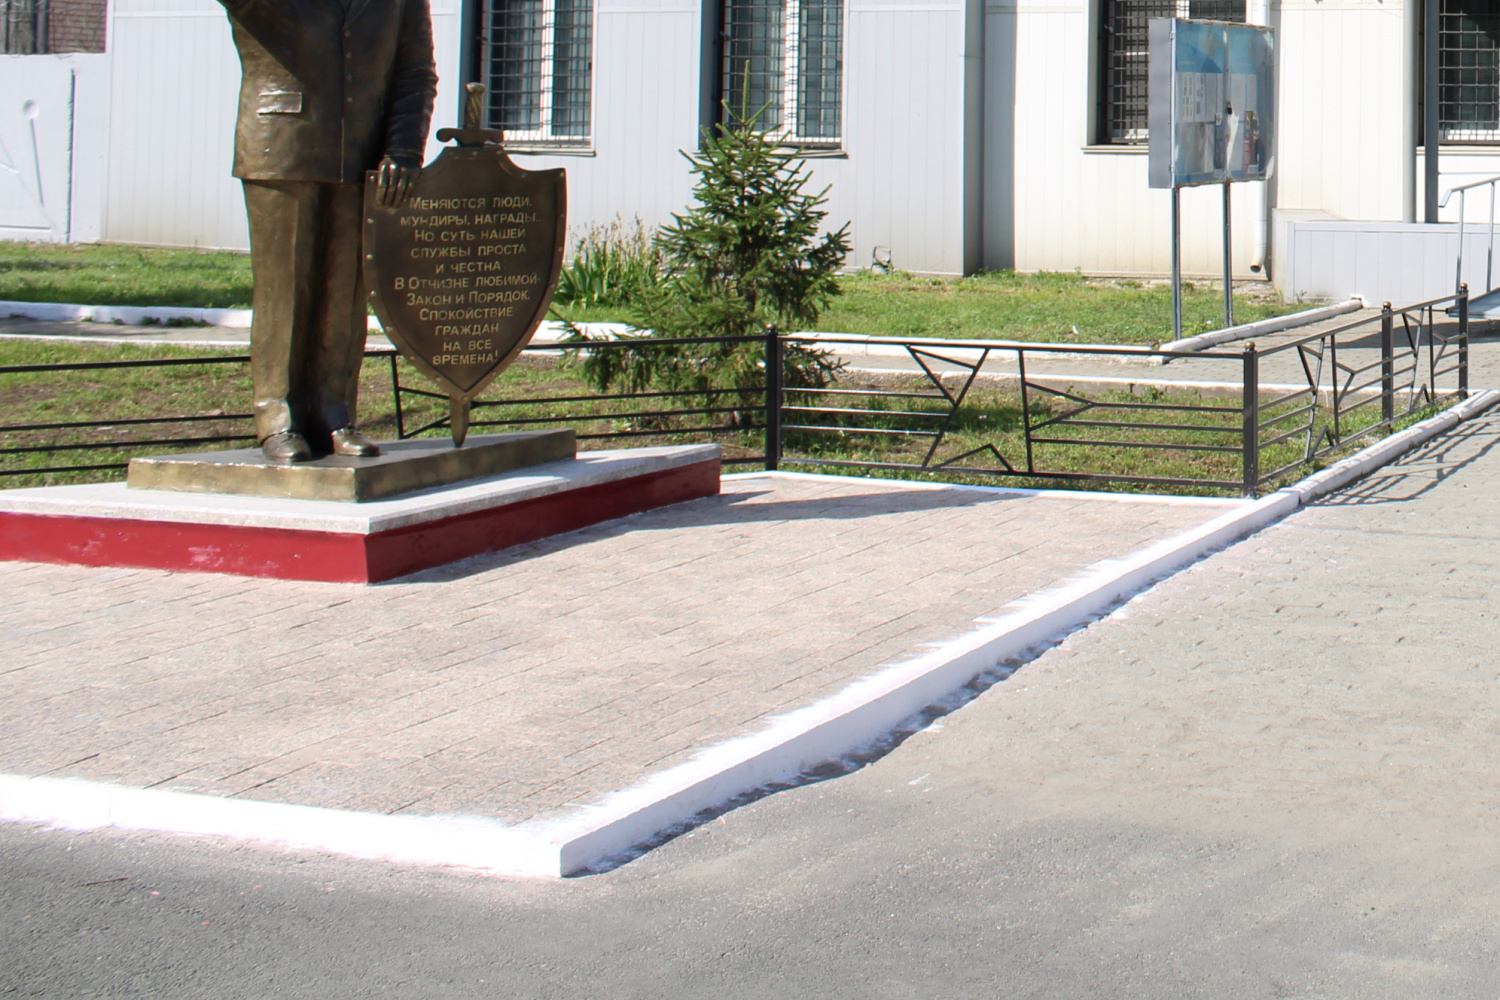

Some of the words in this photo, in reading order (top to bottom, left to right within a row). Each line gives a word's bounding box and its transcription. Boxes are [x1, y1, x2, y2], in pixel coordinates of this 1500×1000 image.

[440, 229, 476, 241] СУТЬ
[480, 225, 527, 240] НАШЕЙ
[410, 245, 471, 259] СЛУЖБЫ
[477, 243, 527, 257] ПРОСТА
[435, 263, 445, 274] И
[394, 277, 404, 290] В
[408, 276, 470, 290] ОТЧИЗНЕ
[406, 293, 452, 306] ЗАКОН
[455, 294, 465, 304] И
[419, 306, 514, 321] СПОКОЙСТВИЕ
[434, 322, 500, 336] ГРАЖДАН
[443, 341, 462, 352] НА
[467, 339, 493, 351] ВСЕ
[432, 349, 499, 366] ВРЕМЕНА!
